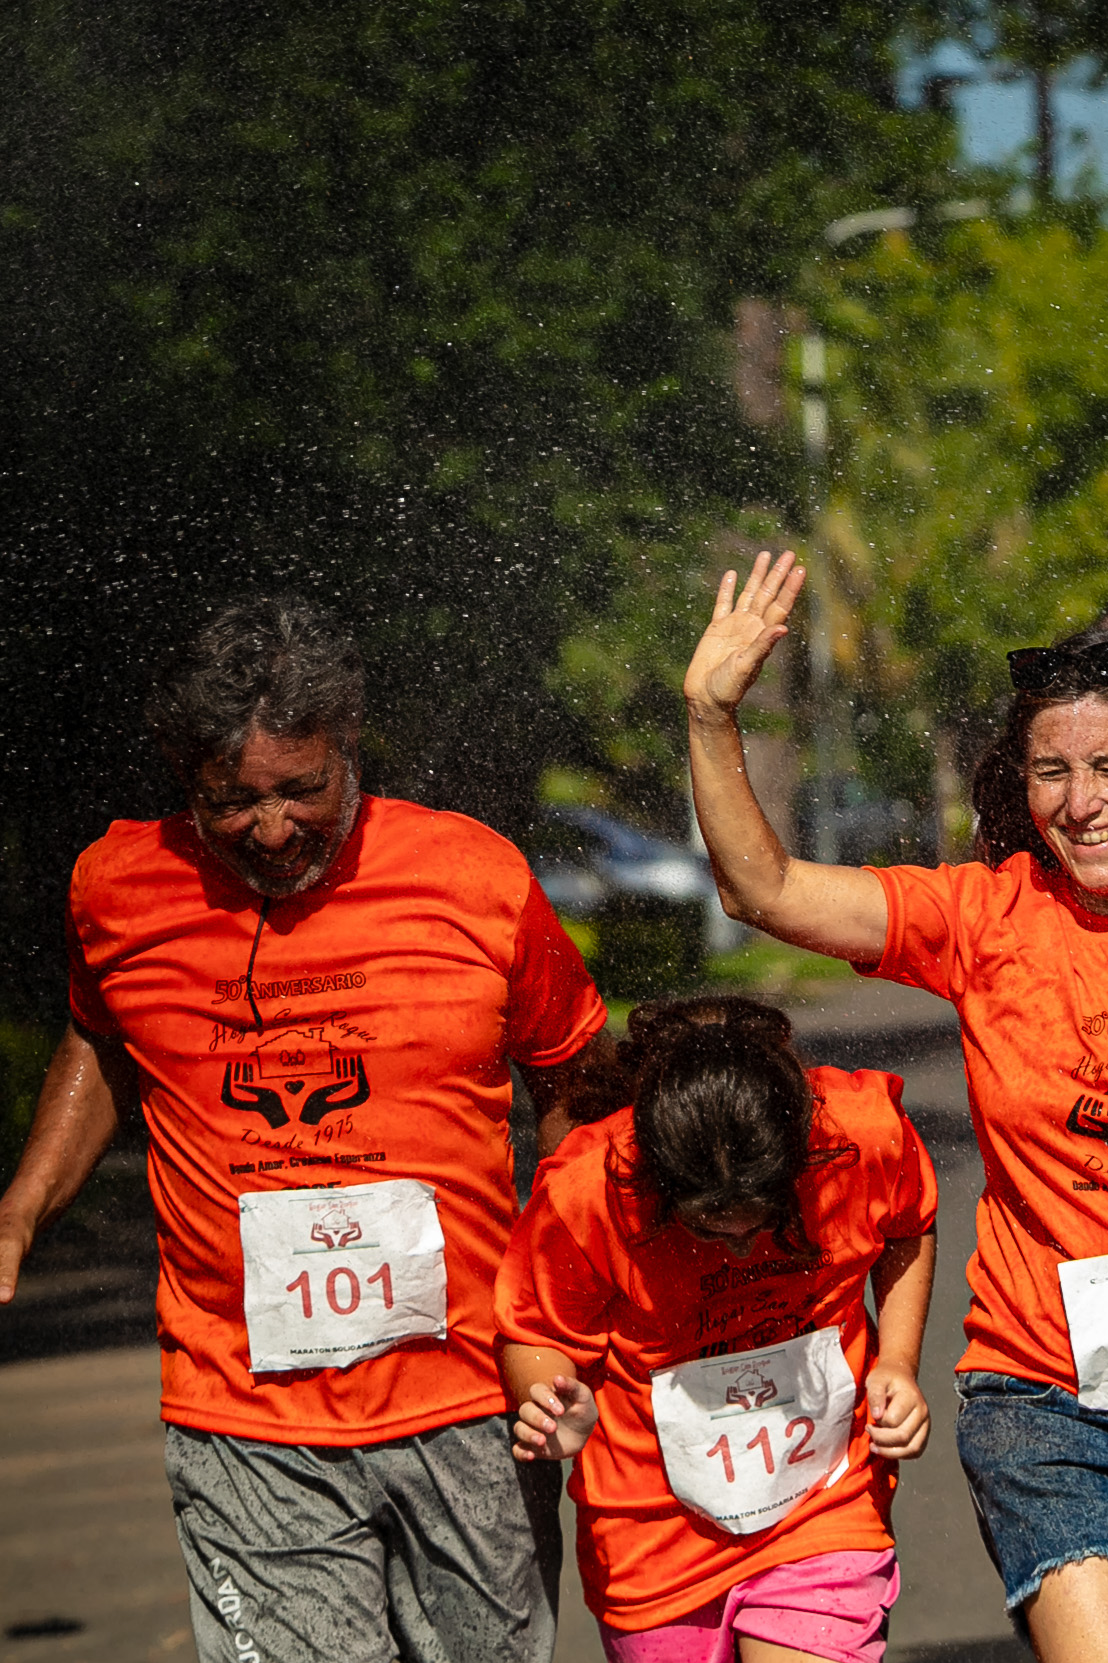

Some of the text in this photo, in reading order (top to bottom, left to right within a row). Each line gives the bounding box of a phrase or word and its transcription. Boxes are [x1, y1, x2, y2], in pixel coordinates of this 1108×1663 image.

[244, 971, 367, 1000] ANIVERSARIO
[320, 1010, 377, 1042] Roque
[240, 1114, 354, 1149] Desde 1975
[286, 1262, 394, 1319] 101
[751, 1289, 790, 1312] San
[706, 1416, 816, 1483] 112
[716, 1509, 756, 1521] MARATON
